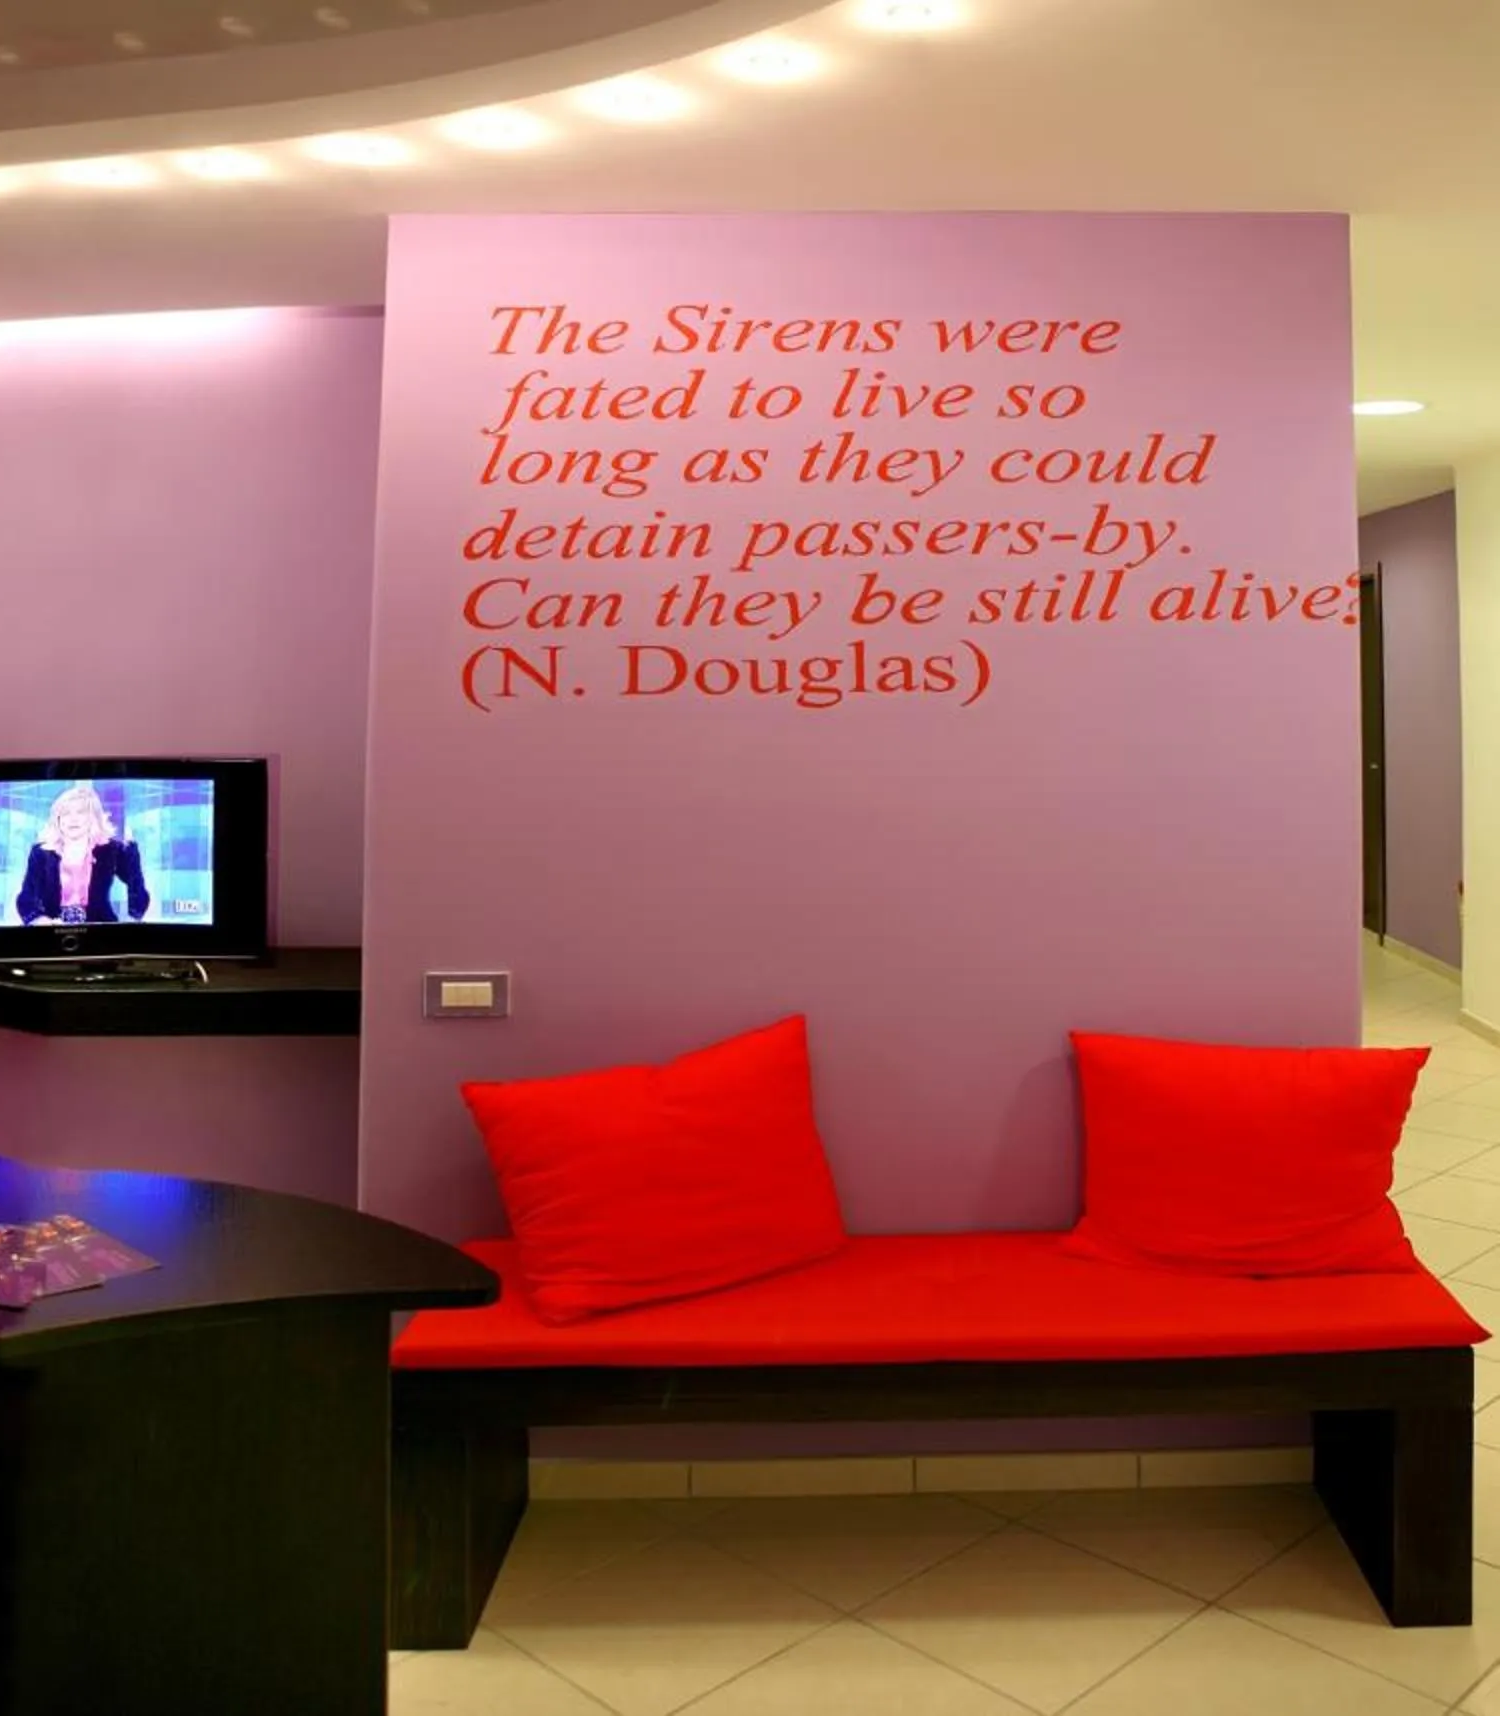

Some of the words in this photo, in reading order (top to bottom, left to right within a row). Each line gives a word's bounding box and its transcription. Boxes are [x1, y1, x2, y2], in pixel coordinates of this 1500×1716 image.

[491, 305, 629, 355] The
[654, 304, 901, 354] Sirens
[931, 319, 1122, 355] were
[482, 368, 706, 434] fated
[730, 378, 803, 420] to
[833, 367, 975, 420] live
[997, 385, 1088, 418] so
[480, 430, 659, 497] long
[682, 448, 768, 484] as
[799, 431, 965, 498] they
[989, 432, 1217, 485] could
[462, 508, 710, 562] detain
[730, 504, 1193, 573] passers-by.
[462, 578, 624, 631] Can
[656, 573, 822, 641] they
[851, 571, 944, 626] be
[968, 568, 1130, 624] still
[460, 644, 586, 714] (N.
[619, 640, 992, 709] Douglas)
